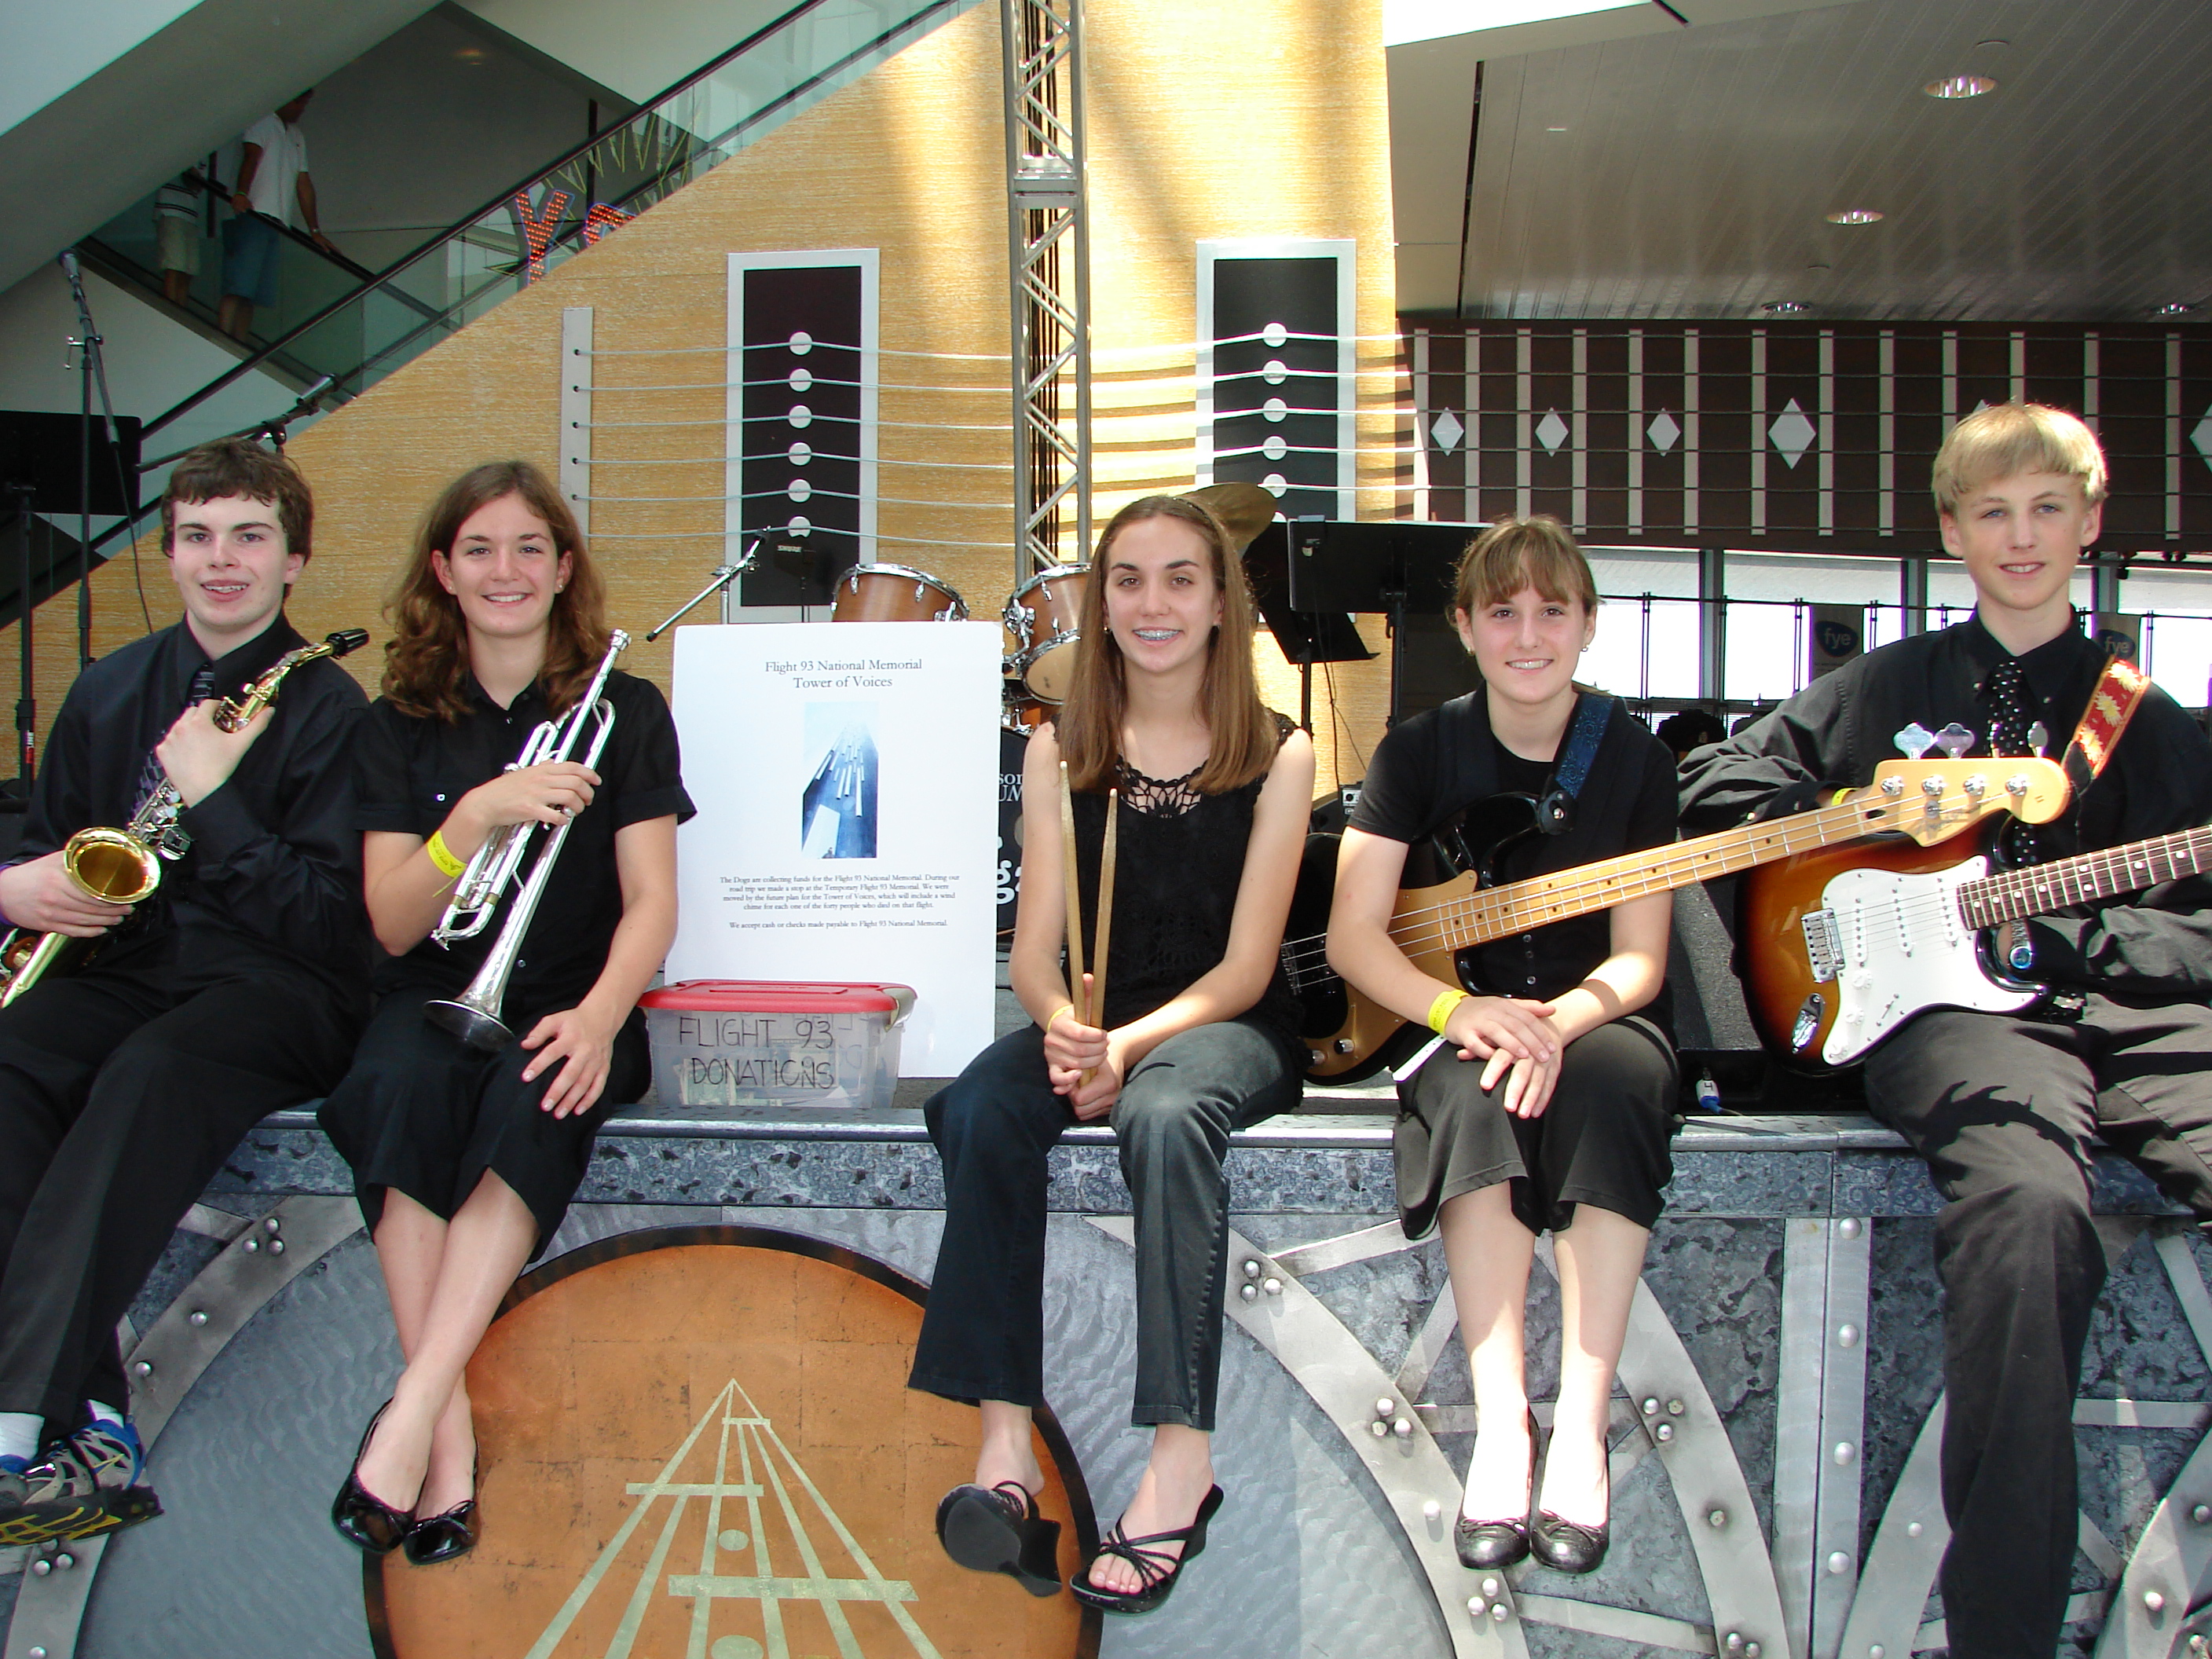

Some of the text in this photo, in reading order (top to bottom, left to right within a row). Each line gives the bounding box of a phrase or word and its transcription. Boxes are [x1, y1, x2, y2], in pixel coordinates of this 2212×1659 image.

[1825, 627, 1852, 650] fye
[2106, 635, 2130, 655] fye
[765, 659, 922, 675] Flight 93 National Memorial
[793, 676, 892, 688] Tower of Voices
[679, 1016, 834, 1049] FLIGHT 93
[691, 1057, 834, 1090] DONATIONS
